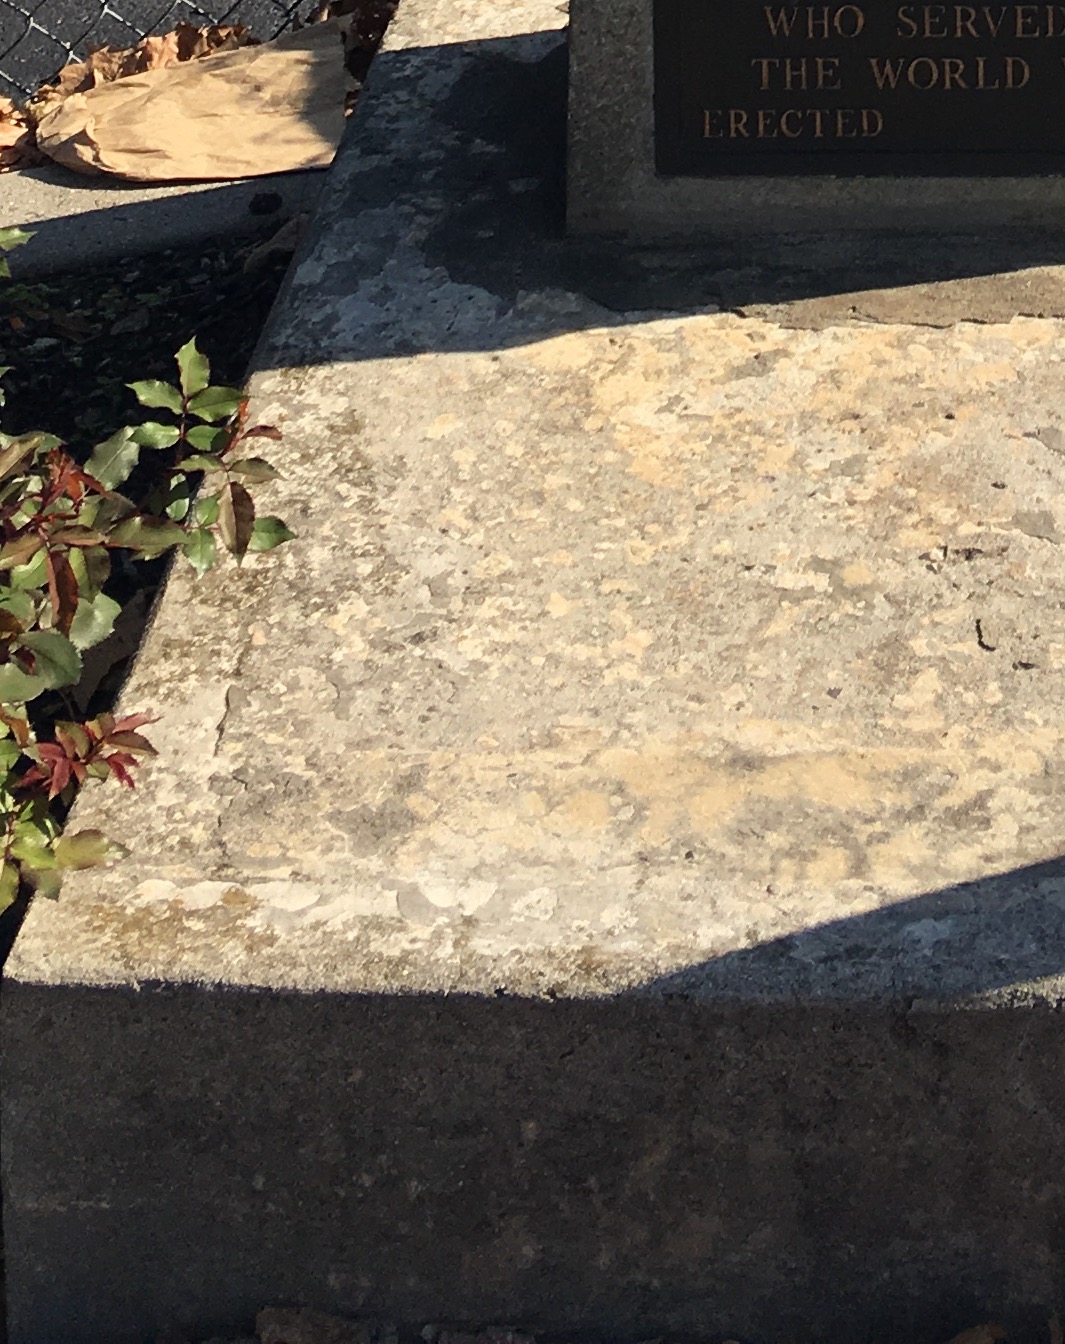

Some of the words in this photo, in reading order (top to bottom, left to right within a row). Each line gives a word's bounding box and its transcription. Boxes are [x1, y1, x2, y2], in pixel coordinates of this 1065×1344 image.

[764, 5, 865, 39] WHO
[751, 58, 842, 90] THE
[869, 57, 1031, 90] WORLD
[702, 109, 884, 139] ERECTED
